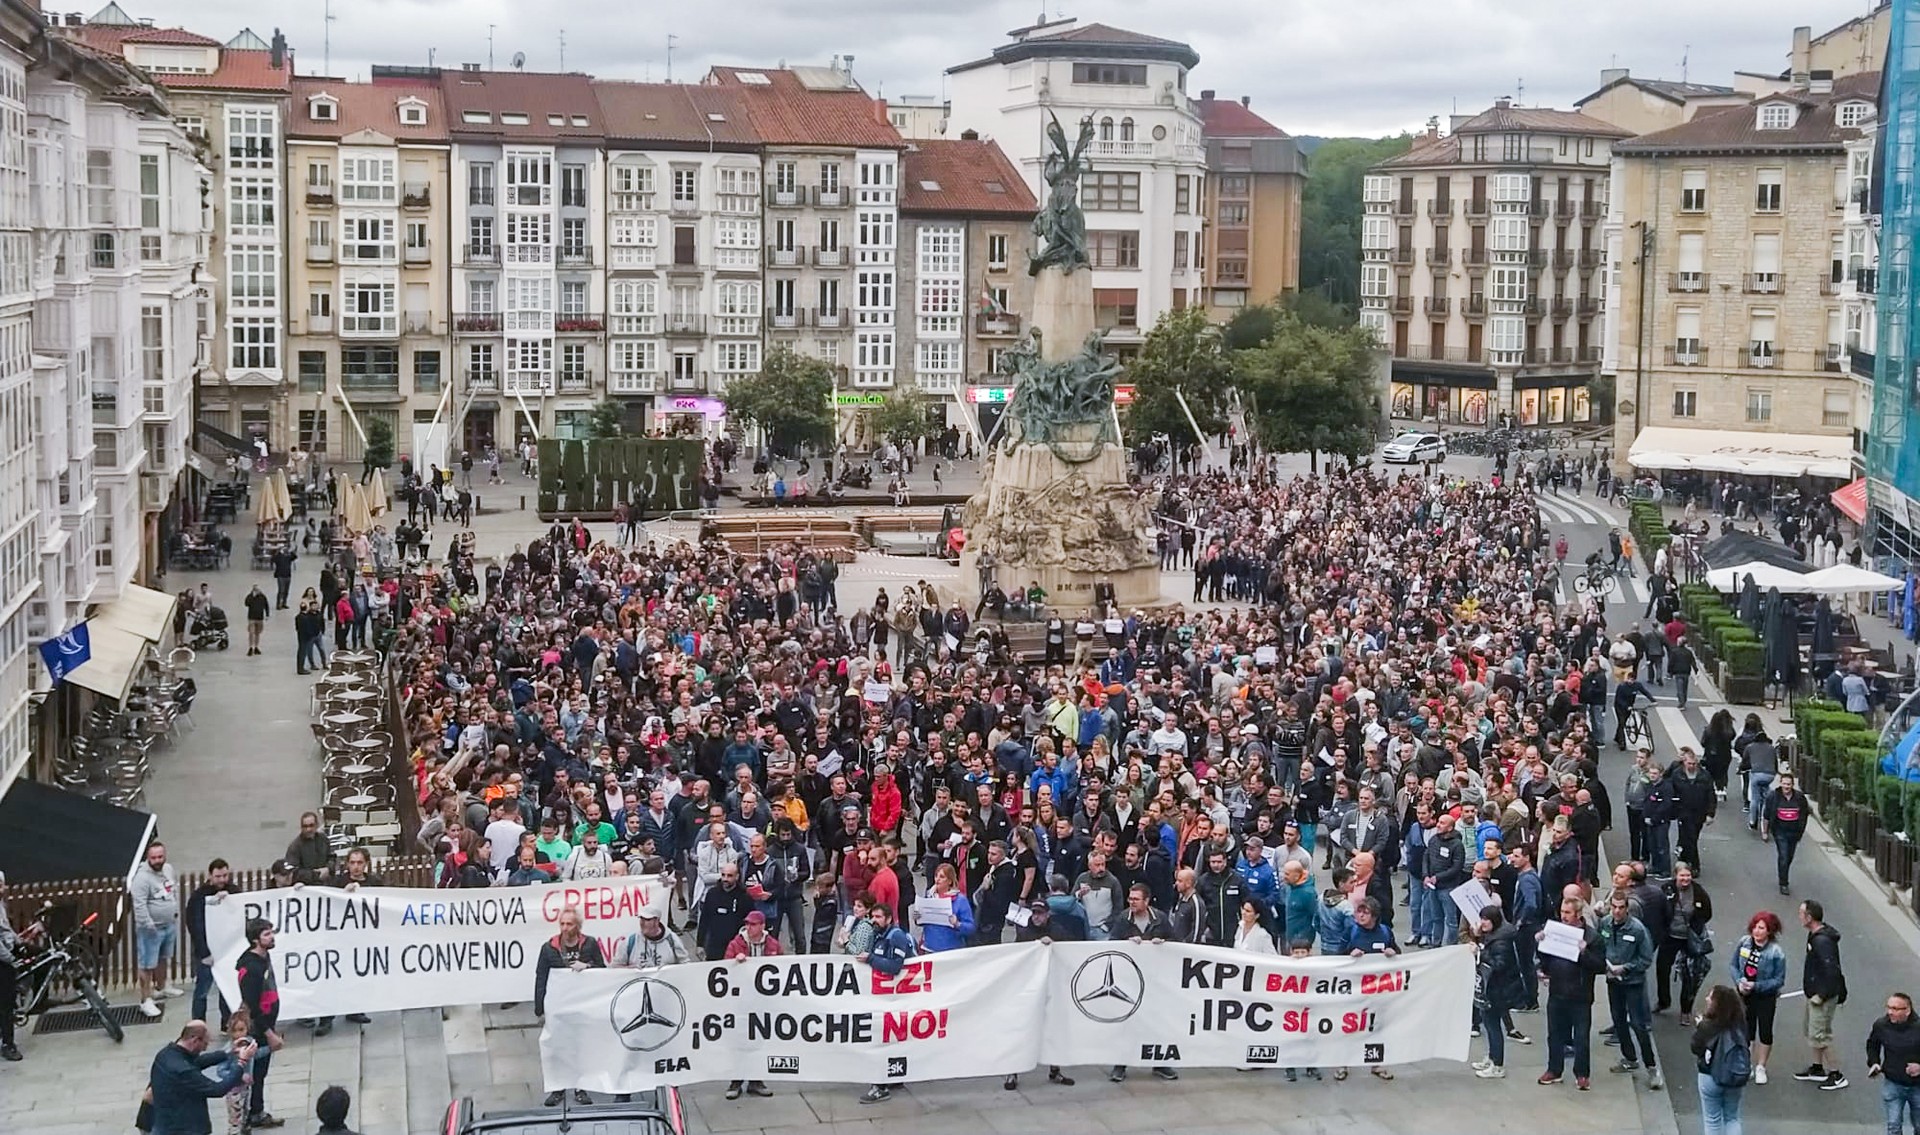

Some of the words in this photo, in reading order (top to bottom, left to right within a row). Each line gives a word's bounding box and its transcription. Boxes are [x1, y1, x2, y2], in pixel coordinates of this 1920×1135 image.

[832, 394, 884, 404] armacia
[401, 897, 527, 926] AERNNOVA
[285, 949, 341, 983] POR
[353, 946, 389, 977] UN
[401, 941, 524, 974] CONVENIO
[1181, 957, 1255, 992] KPI
[1266, 973, 1309, 993] BAI
[1315, 976, 1352, 994] ala
[1360, 970, 1410, 995] BAI!
[708, 966, 740, 998] 6.
[754, 963, 860, 997] GAUA
[871, 961, 933, 995] EZ!
[748, 1012, 872, 1043] NOCHE
[882, 1008, 948, 1043] NO!
[1189, 999, 1274, 1035] ¡IPC
[1283, 1007, 1310, 1033] SÍ
[1318, 1018, 1333, 1034] o
[654, 1057, 691, 1074] ELA
[769, 1056, 799, 1069] LAB
[1141, 1044, 1181, 1061] ELA
[1248, 1046, 1277, 1059] LAB
